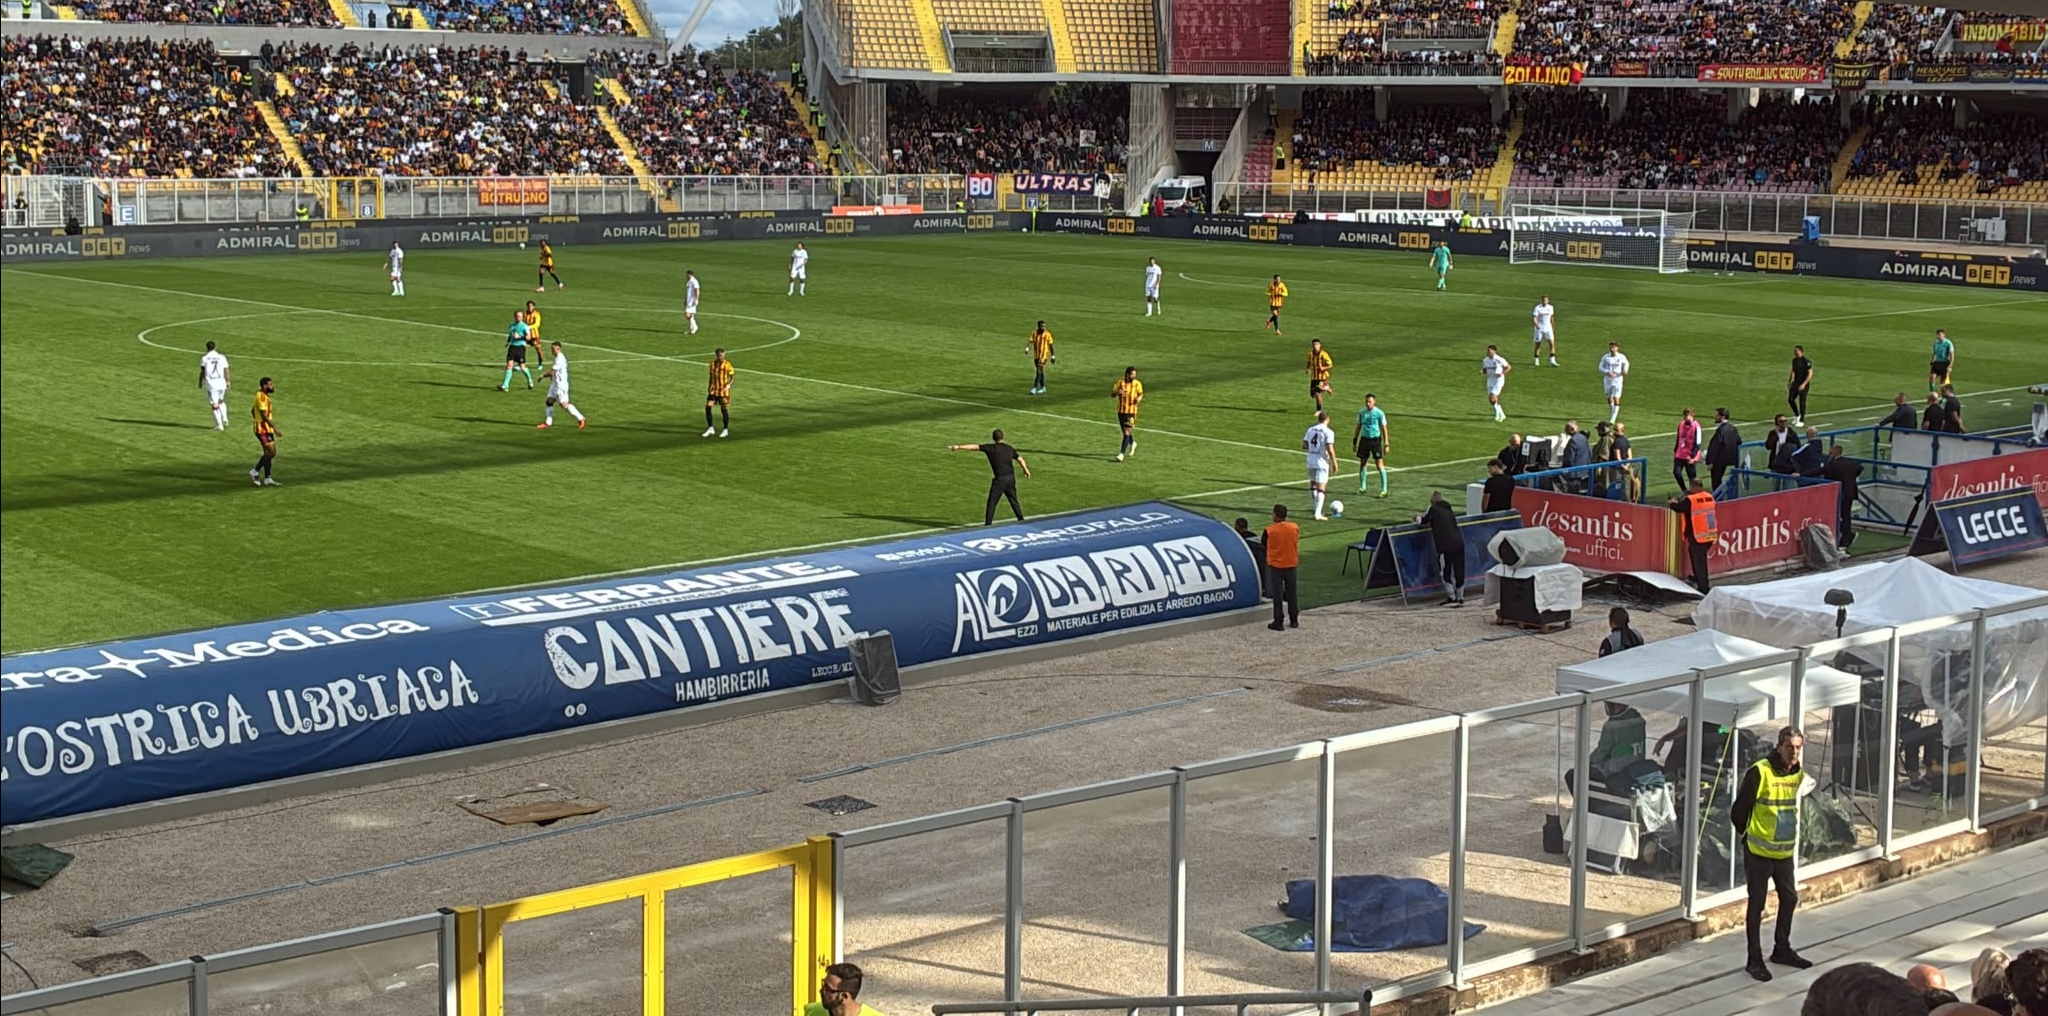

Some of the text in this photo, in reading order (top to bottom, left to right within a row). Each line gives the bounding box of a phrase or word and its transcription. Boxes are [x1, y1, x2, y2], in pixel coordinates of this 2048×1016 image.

[1505, 66, 1570, 85] ZOLLINO
[1717, 67, 1744, 79] SOUTH
[1779, 67, 1807, 79] GROUP
[969, 177, 992, 196] BO
[1016, 174, 1093, 191] ULTRAS
[481, 191, 548, 203] BOTRUGNO
[122, 207, 133, 222] E
[913, 217, 966, 229] ADMIRAL
[968, 216, 993, 228] BET
[603, 224, 666, 238] ADMIRAL
[668, 224, 699, 237] BET
[766, 220, 823, 233] ADMIRAL
[826, 220, 853, 232] BET
[1055, 217, 1106, 230] ADMIRAL
[1108, 220, 1134, 232] BET
[1193, 224, 1248, 238] ADMIRAL
[1250, 227, 1277, 240] BET
[217, 234, 296, 249] ADMIRAL
[299, 234, 336, 248] BET
[420, 229, 491, 243] ADMIRAL
[494, 229, 528, 242] BET
[1338, 231, 1397, 246] ADMIRAL
[1399, 234, 1430, 247] BET
[83, 240, 124, 255] BET
[1499, 240, 1565, 256] ADMIRAL
[1568, 243, 1601, 257] BET
[1679, 251, 1753, 266] ADMIRAL
[1756, 253, 1793, 268] BET
[1880, 262, 1964, 281] ADMIRAL
[1967, 266, 2009, 282] BET
[211, 360, 219, 374] 7
[1310, 432, 1318, 447] 4
[1531, 500, 1633, 541] desantis
[1957, 505, 2028, 545] LECCE
[1707, 508, 1791, 559] santis
[500, 561, 825, 613] FERRANTE
[1047, 590, 1234, 632] MATERIALE PER EDILIZIA E ARREDO BAGNO
[545, 588, 870, 689] CANTIERE
[1017, 624, 1038, 638] EZZI
[143, 619, 430, 669] Medica
[675, 667, 770, 702] HAMBIRRERIA
[1, 659, 479, 781] 'OSTRICA UBRIACA
